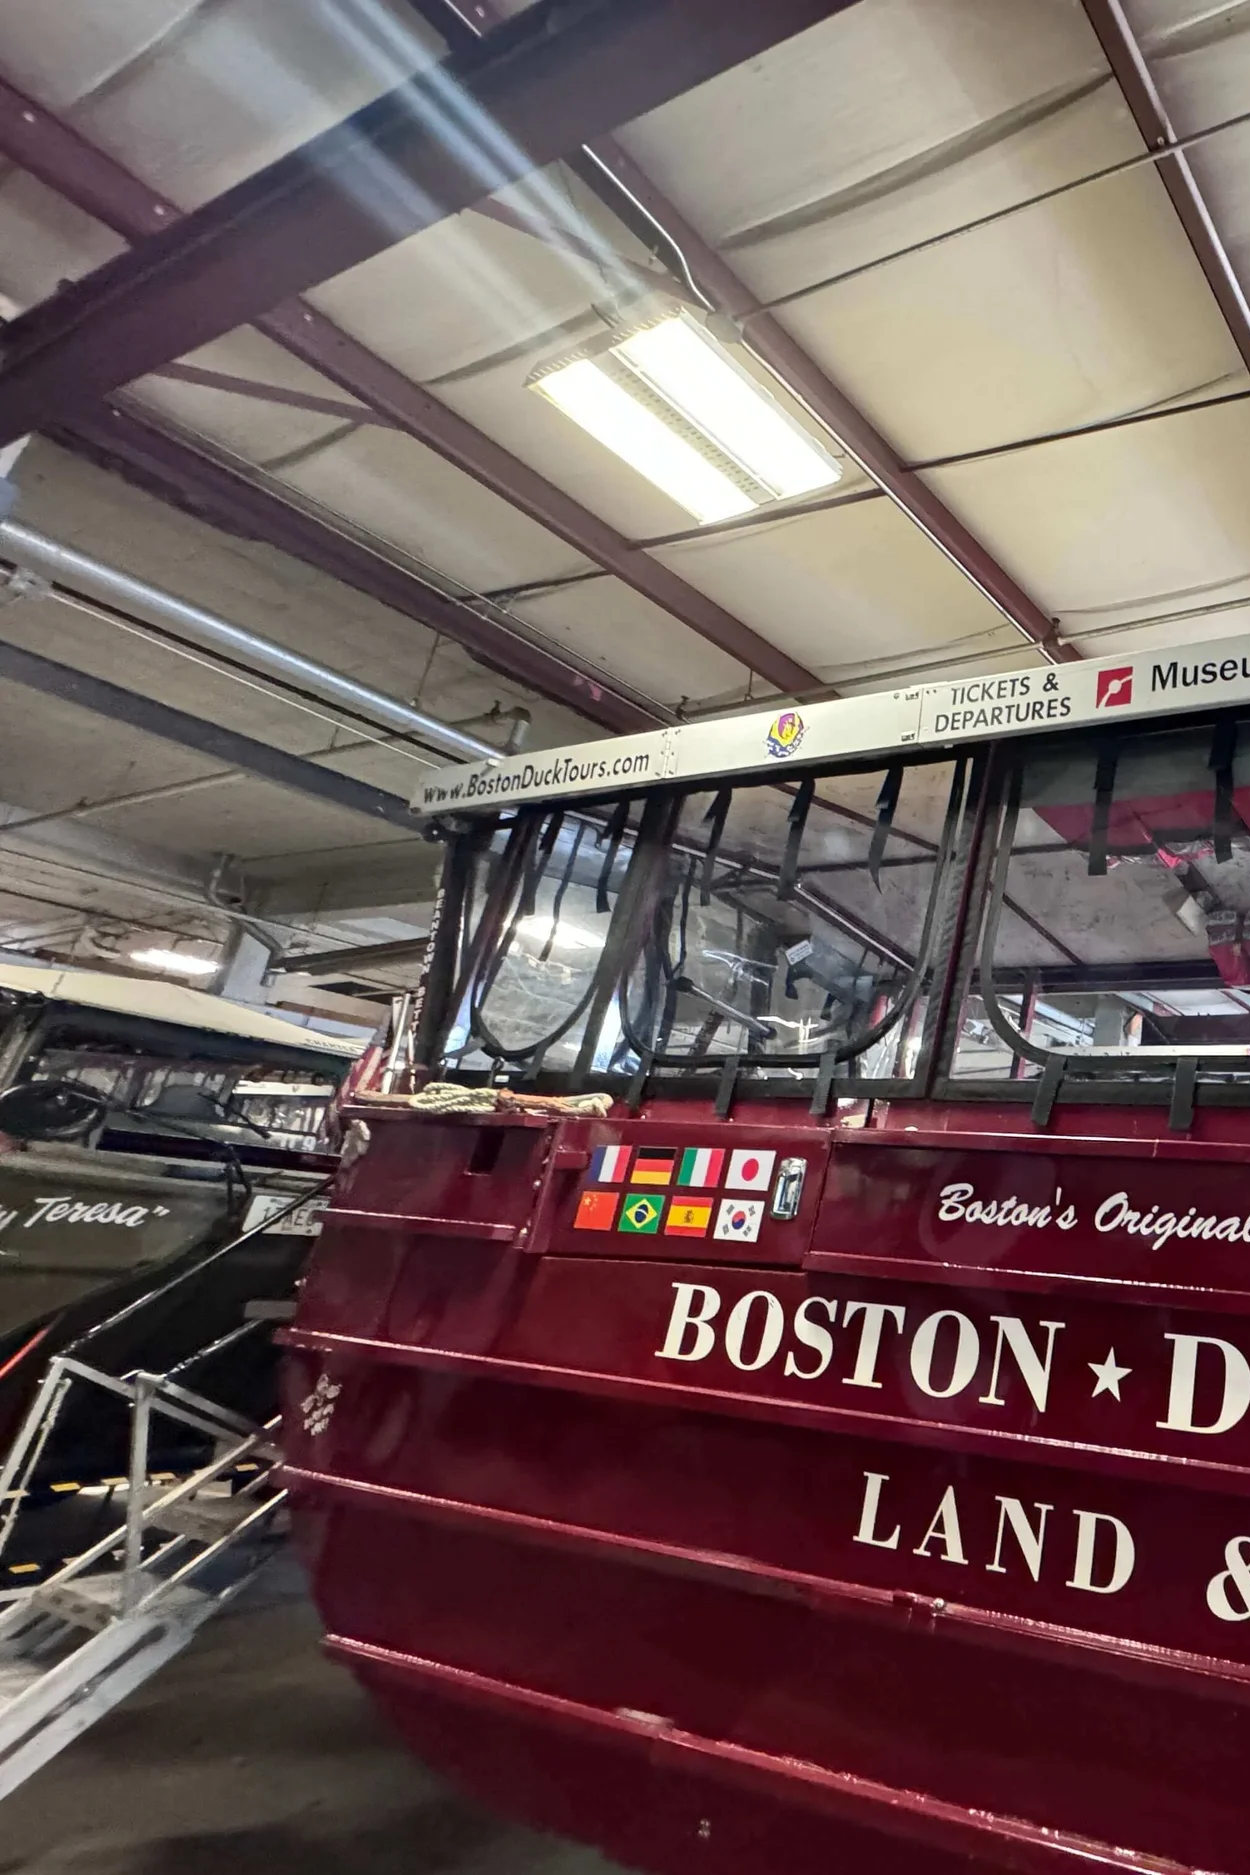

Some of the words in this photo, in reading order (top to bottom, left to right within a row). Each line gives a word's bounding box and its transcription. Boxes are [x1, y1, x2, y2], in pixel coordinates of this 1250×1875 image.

[951, 675, 1031, 706] TICKETS
[1043, 671, 1060, 693] &
[934, 696, 1072, 734] DEPARTURES
[423, 753, 650, 804] www.BostonDuckTours.com
[938, 1182, 1079, 1231] Boston's
[654, 1282, 1067, 1413] BOSTON
[852, 1471, 1136, 1595] LAND
